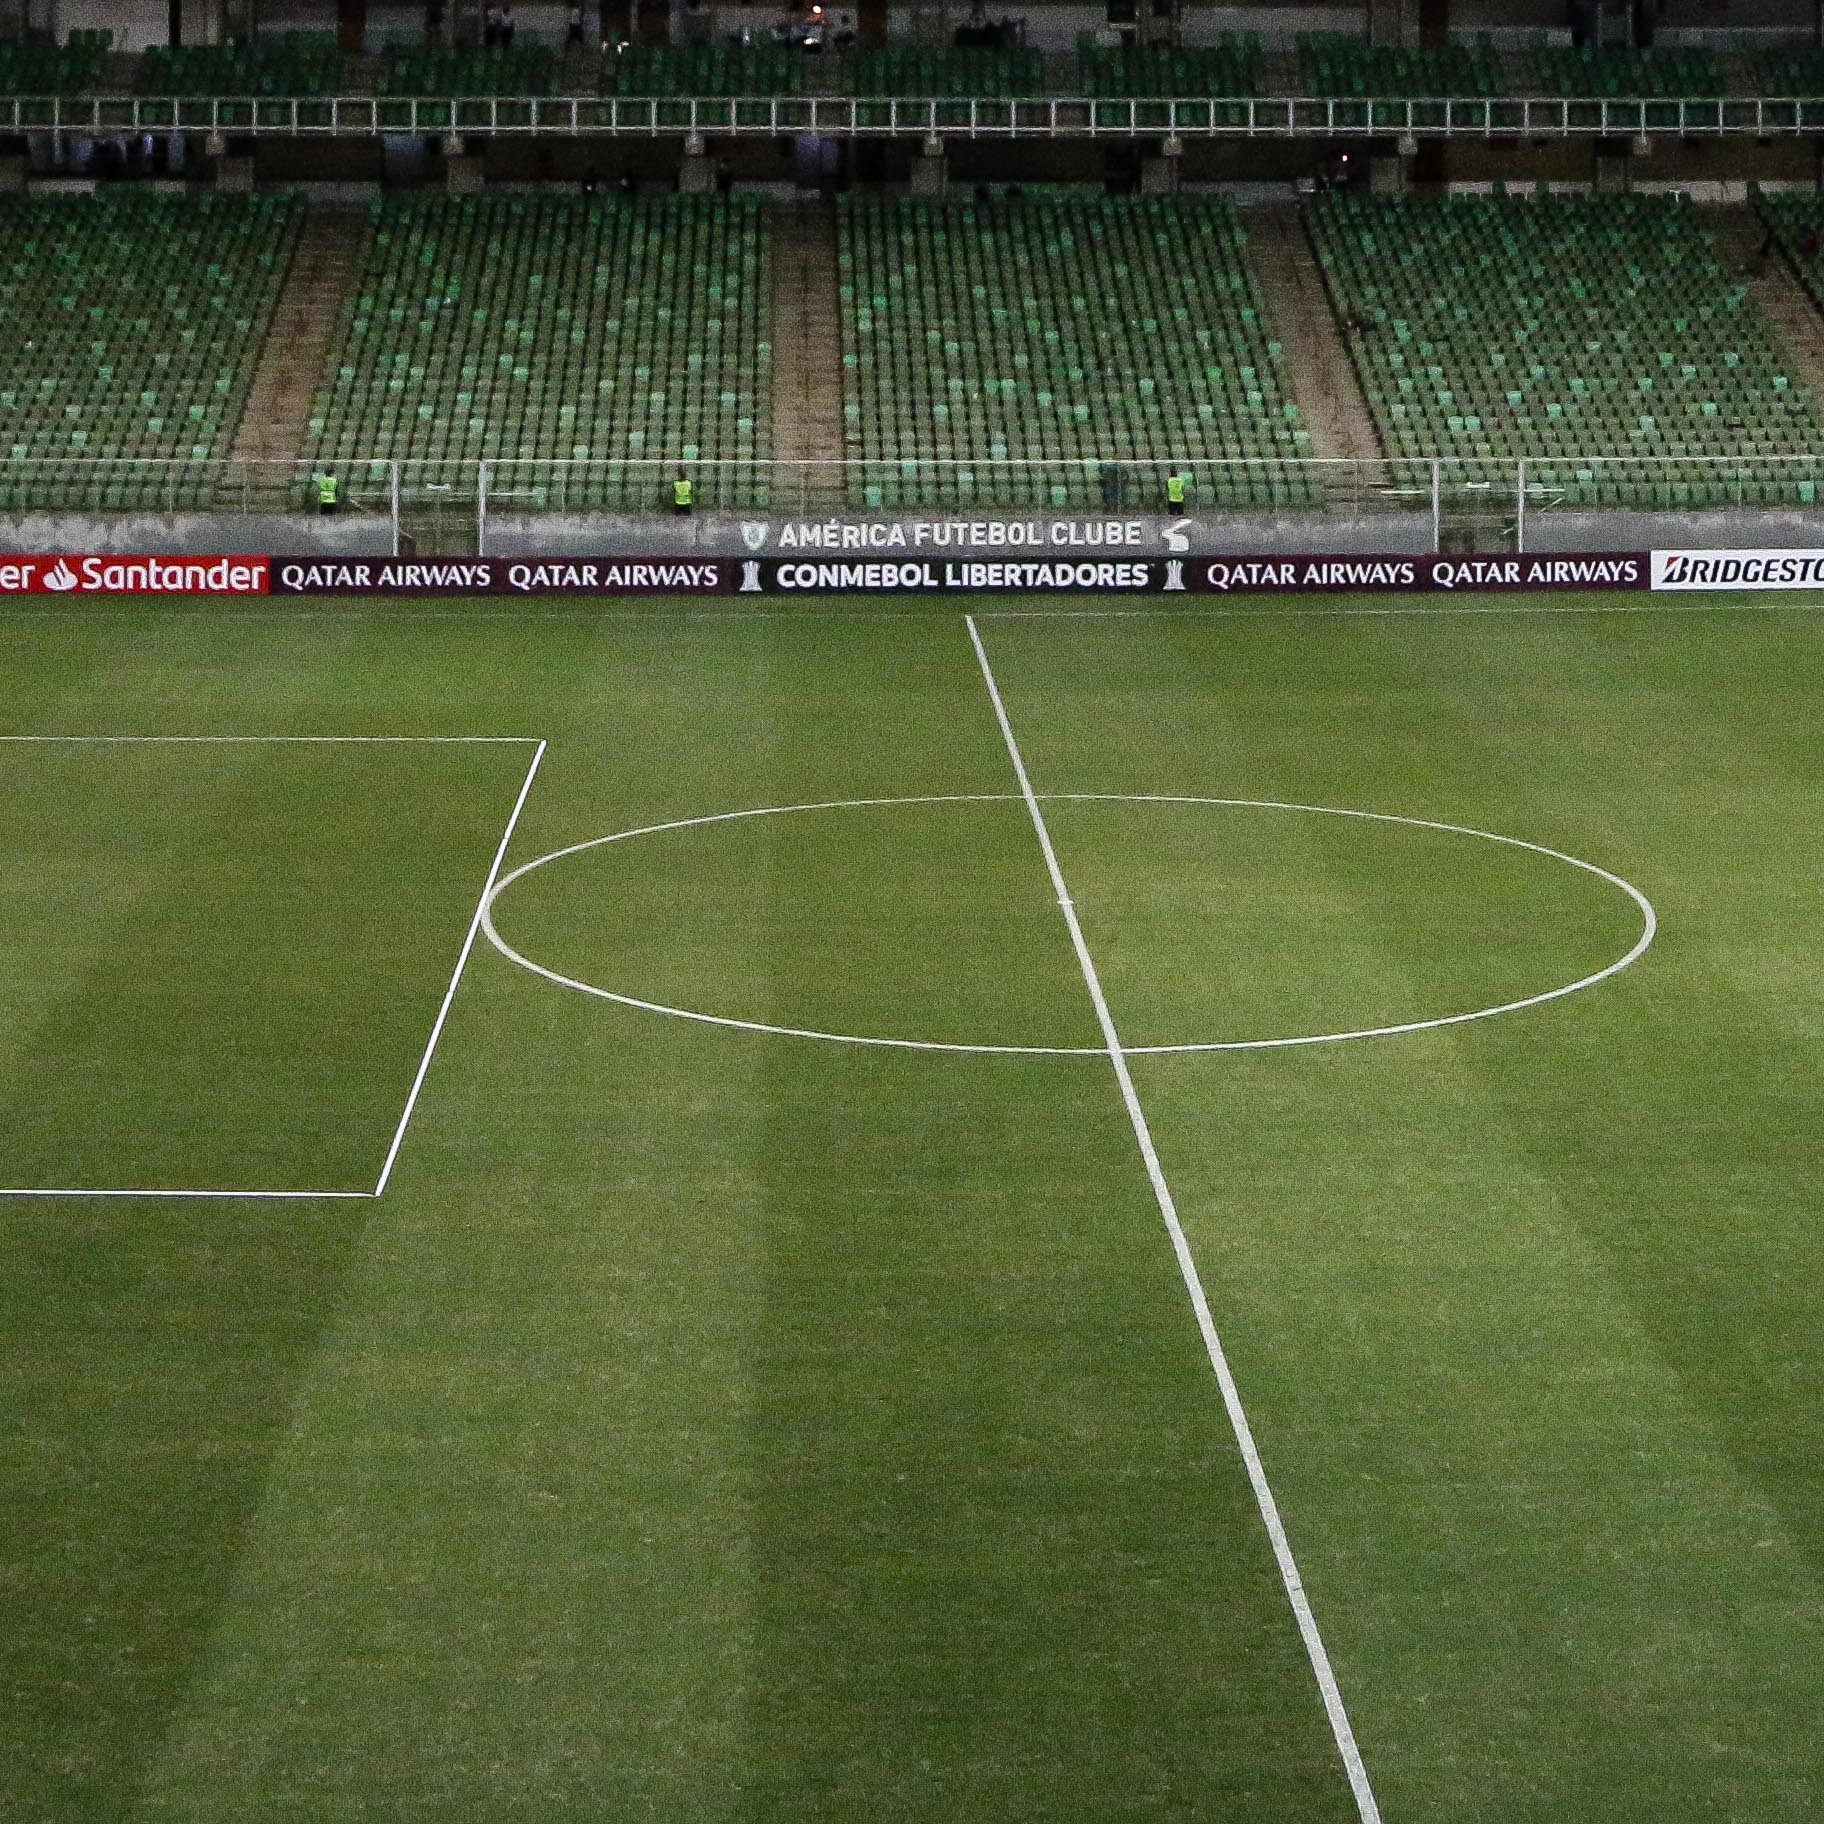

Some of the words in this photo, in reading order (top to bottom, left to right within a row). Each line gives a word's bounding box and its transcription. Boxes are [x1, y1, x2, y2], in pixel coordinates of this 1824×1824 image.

[778, 518, 906, 548] AMÉRICA
[915, 522, 1043, 547] FUTEBOL
[1052, 521, 1141, 546] CLUBE
[81, 558, 266, 590] Santander
[282, 564, 370, 589] QATAR
[378, 564, 491, 587] AIRWAYS
[508, 564, 597, 589] QATAR
[605, 564, 718, 587] AIRWAYS
[777, 563, 939, 588] CONMEBOL
[945, 562, 1148, 587] LIBERTADORES
[1207, 563, 1296, 587] QATAR
[1303, 562, 1414, 585] AIRWAYS
[1432, 561, 1520, 587] QATAR
[1527, 560, 1638, 583] AIRWAYS
